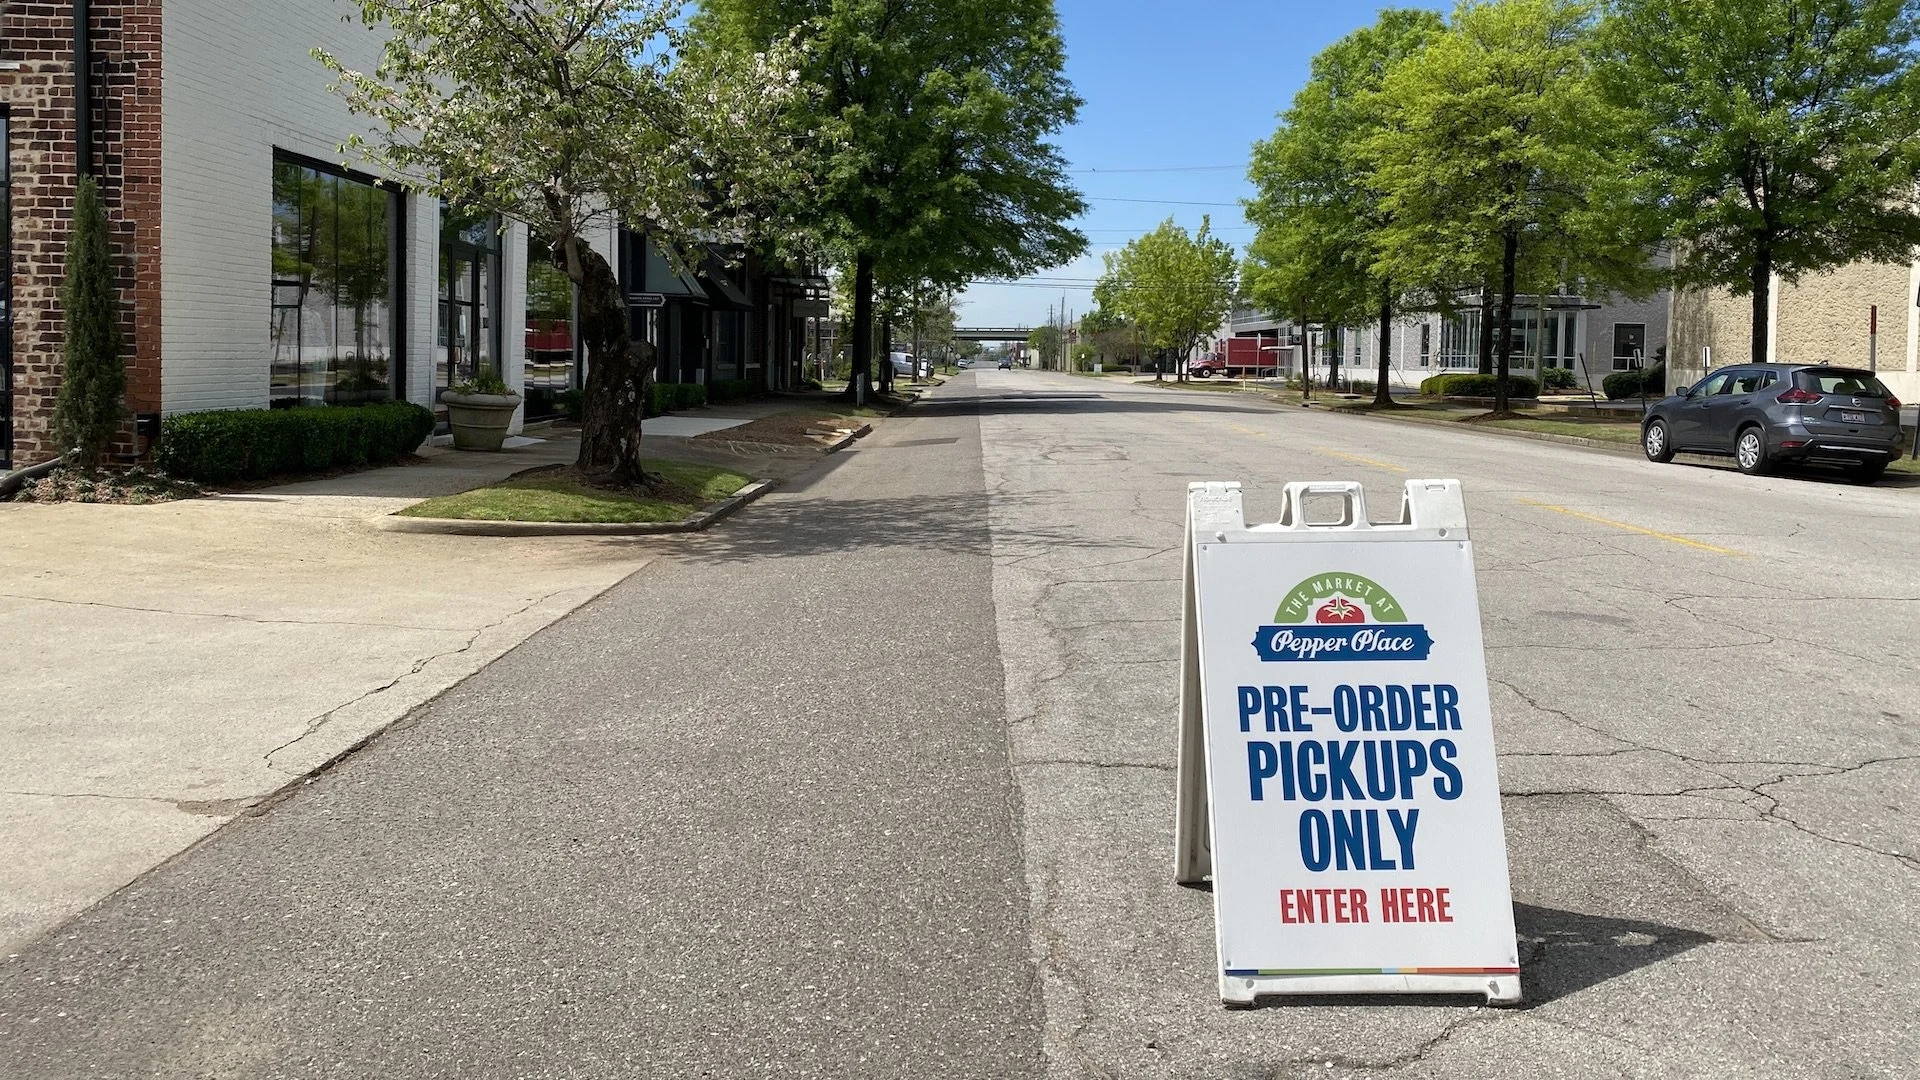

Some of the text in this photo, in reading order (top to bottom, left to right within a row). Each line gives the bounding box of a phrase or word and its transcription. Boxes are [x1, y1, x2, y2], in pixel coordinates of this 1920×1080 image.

[1285, 577, 1394, 616] THE MARKET AT
[1270, 629, 1415, 659] Pepper Place
[1238, 684, 1463, 733] PRE-ORDER
[1248, 739, 1464, 802] PICKUPS
[1299, 808, 1420, 873] ONLY
[1280, 887, 1454, 924] ENTER HERE
